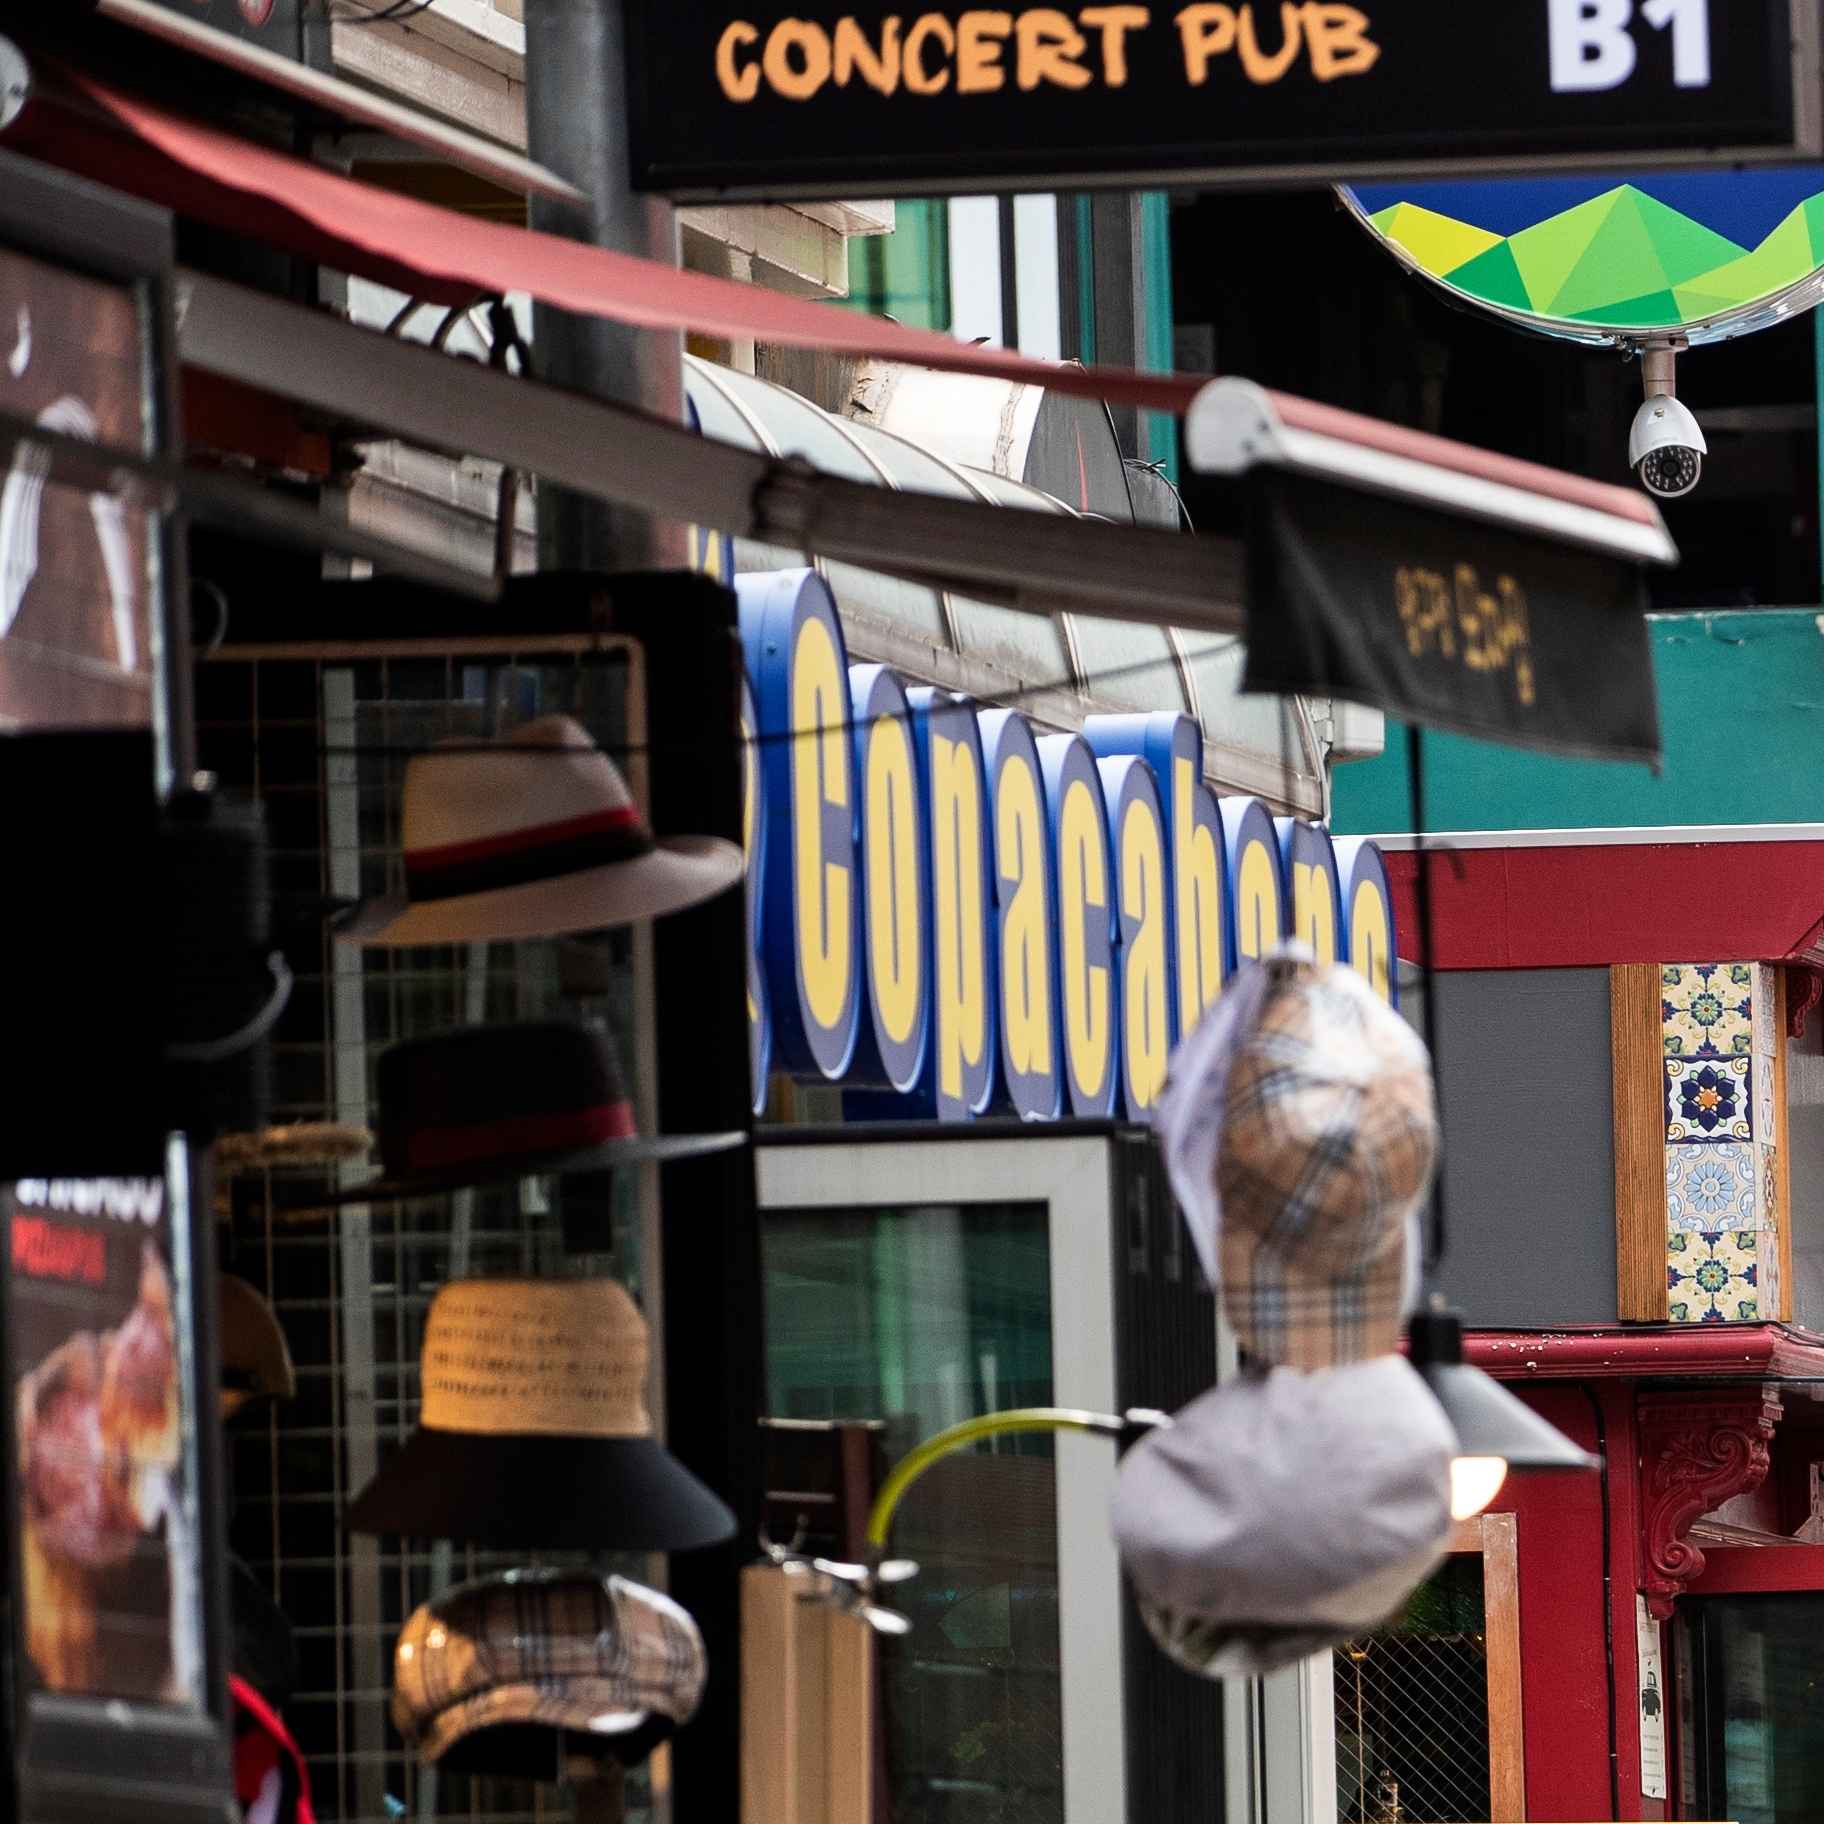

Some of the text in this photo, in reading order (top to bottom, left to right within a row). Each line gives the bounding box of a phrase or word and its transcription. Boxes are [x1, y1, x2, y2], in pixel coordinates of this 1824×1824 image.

[716, 0, 1712, 101] CONCERT PUB B1
